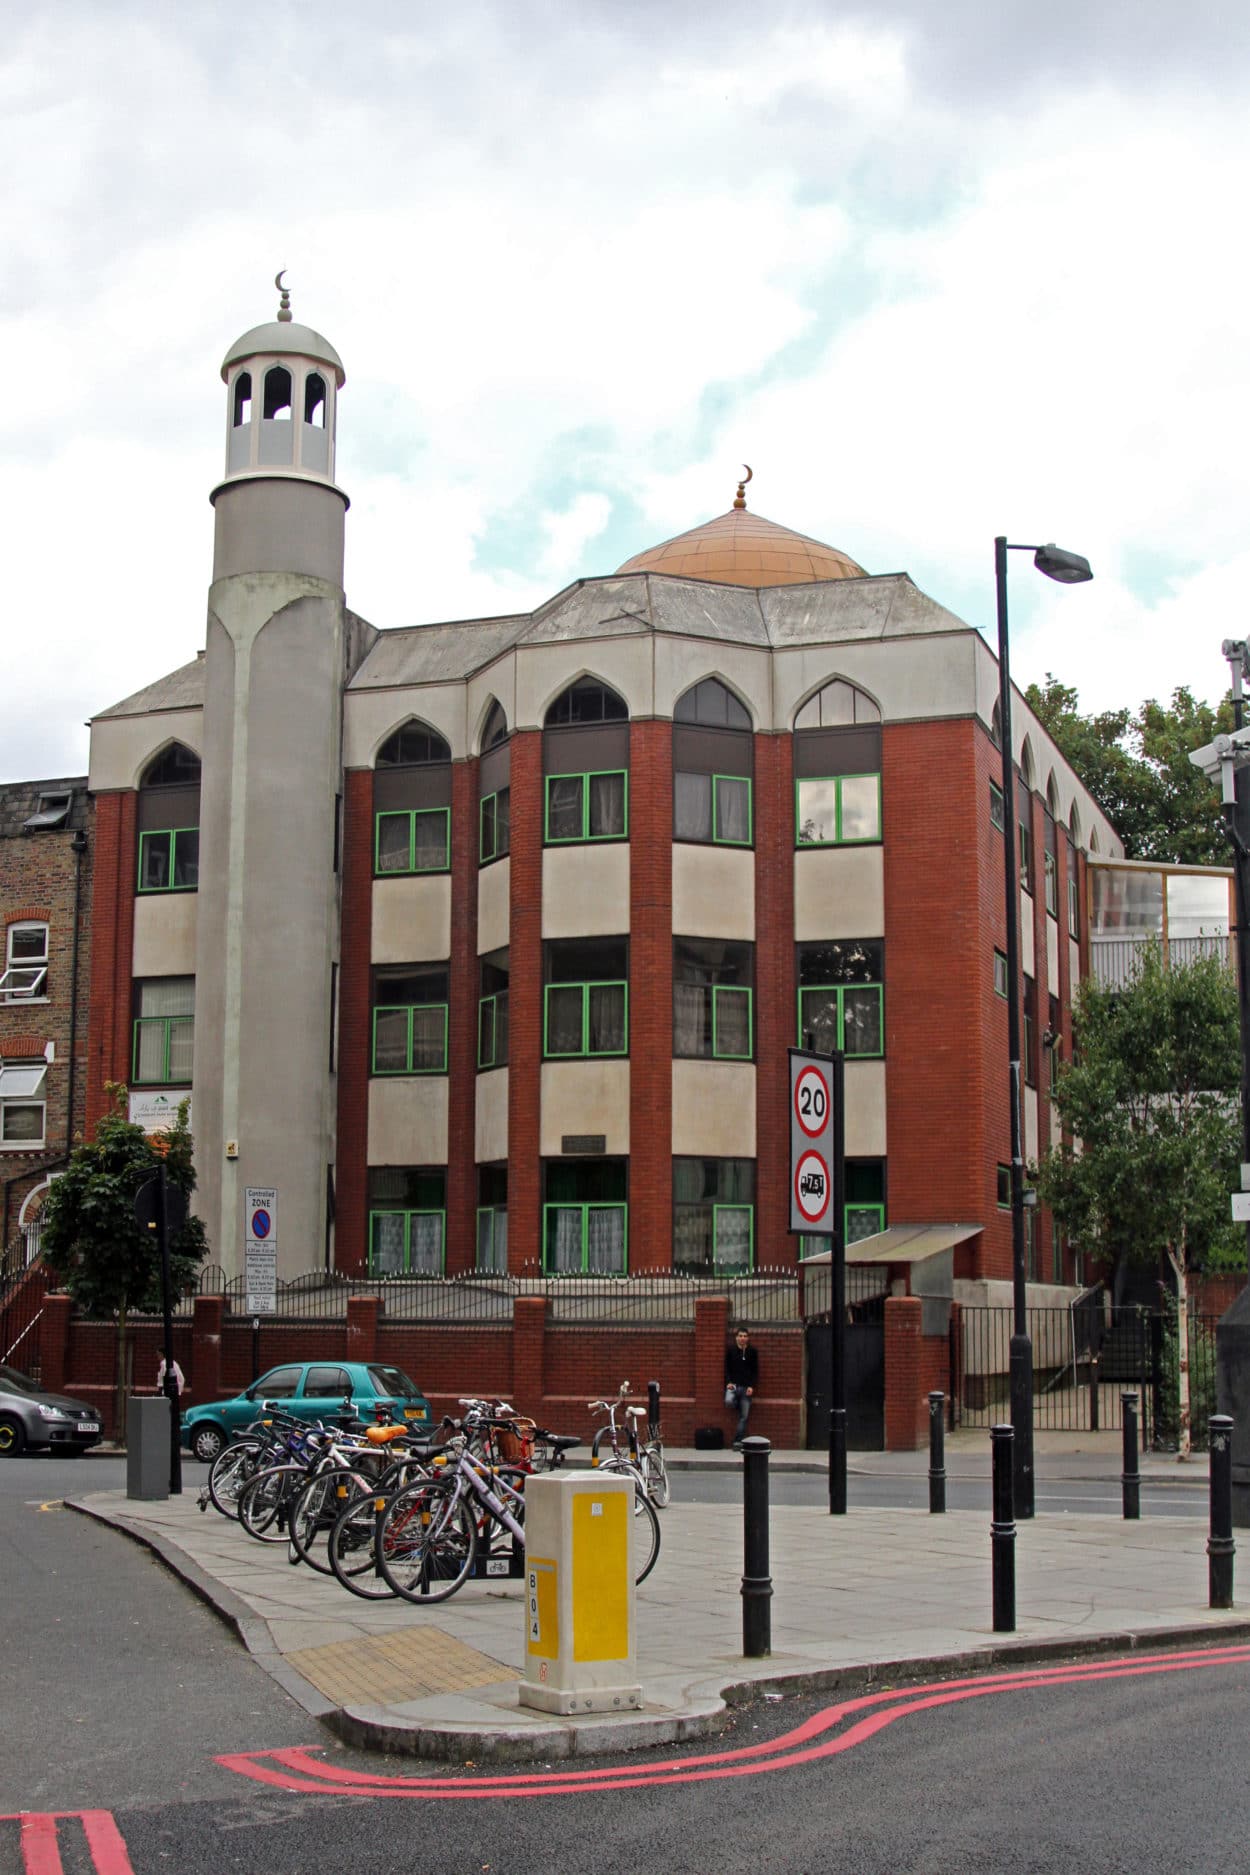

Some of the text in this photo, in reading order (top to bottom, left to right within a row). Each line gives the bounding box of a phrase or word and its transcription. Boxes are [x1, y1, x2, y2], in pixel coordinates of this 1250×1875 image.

[801, 1086, 825, 1117] 20
[248, 1190, 275, 1198] Controlled
[252, 1198, 271, 1207] ZONE
